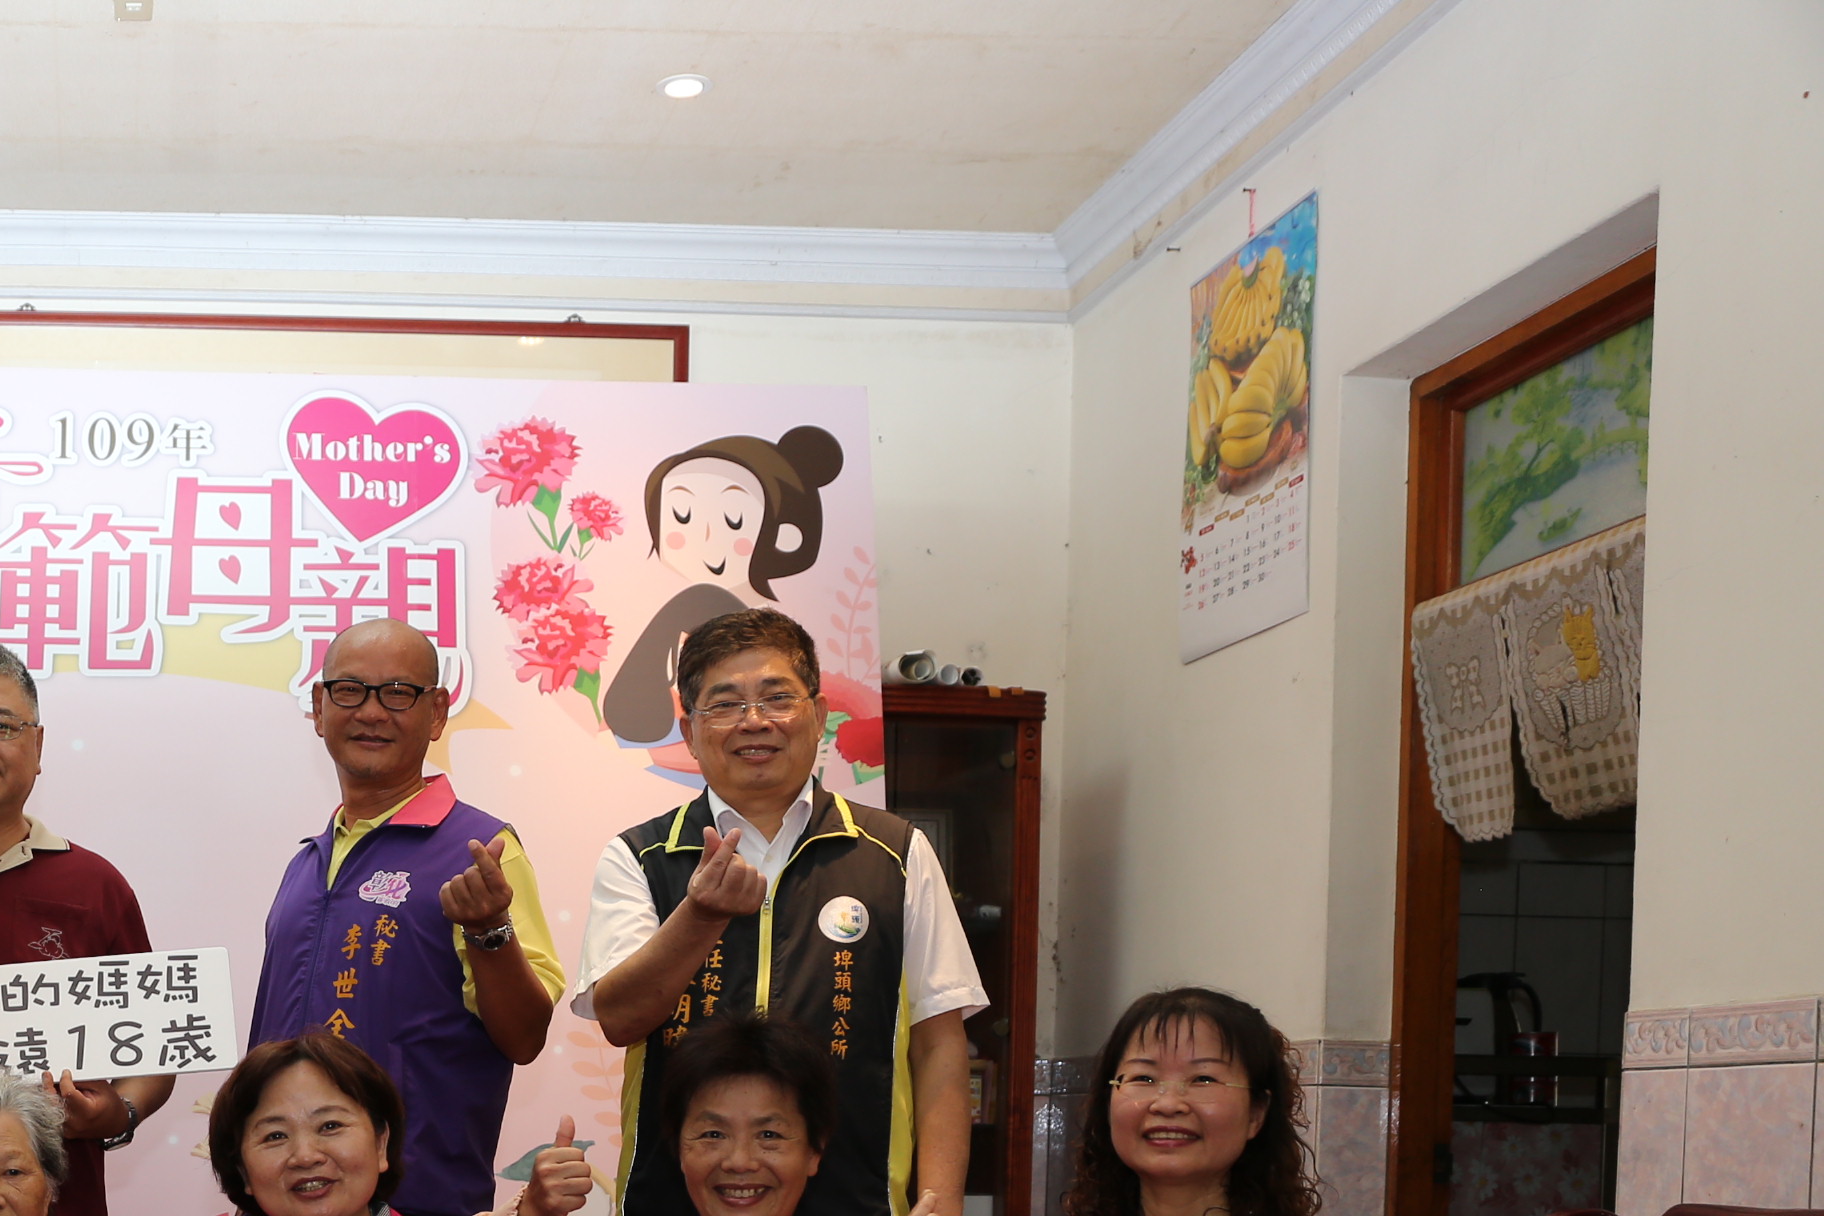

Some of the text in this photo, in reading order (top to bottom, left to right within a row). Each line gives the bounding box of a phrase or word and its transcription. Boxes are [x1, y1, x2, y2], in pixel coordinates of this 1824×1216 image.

[54, 416, 210, 466] 109年
[293, 432, 451, 463] Mother's
[336, 471, 409, 507] Day
[370, 913, 399, 966] 秘書
[324, 923, 364, 1040] 李世全
[700, 939, 724, 1017] 任秘書
[830, 949, 855, 1060] 埤頭鄉公所
